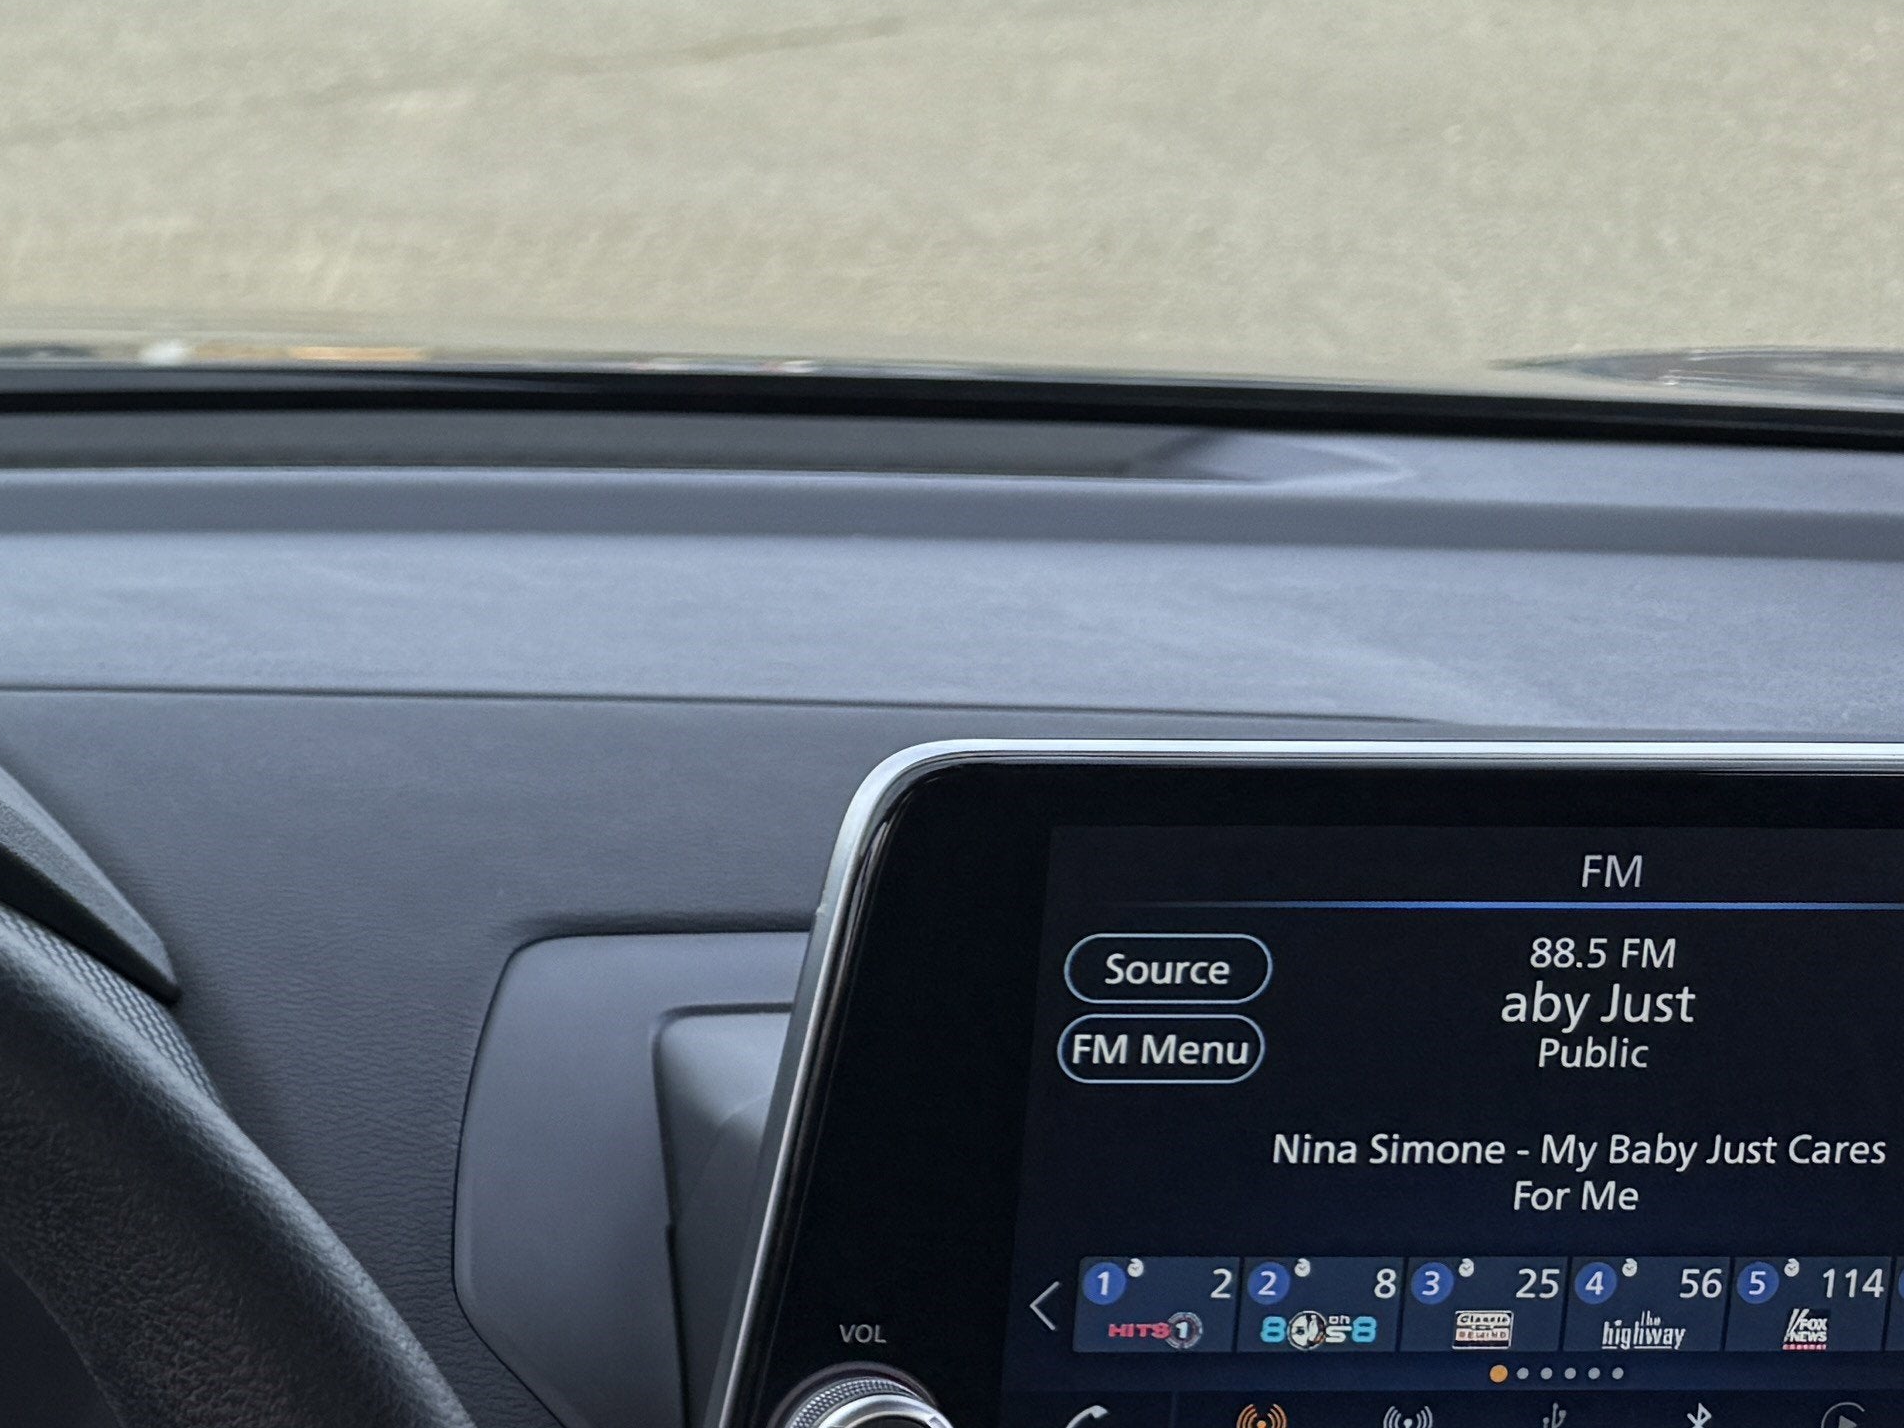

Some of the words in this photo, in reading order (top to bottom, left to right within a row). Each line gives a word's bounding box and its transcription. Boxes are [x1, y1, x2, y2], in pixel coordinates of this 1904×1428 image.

[1581, 854, 1644, 889] FM
[1529, 937, 1608, 969] 88.5
[1622, 938, 1676, 969] FM
[1104, 953, 1230, 986] Source
[1501, 980, 1590, 1034] aby
[1601, 982, 1696, 1024] Just
[1072, 1034, 1128, 1065] FM
[1141, 1035, 1249, 1065] Menu
[1538, 1035, 1649, 1068] Public
[1273, 1133, 1358, 1165] Nina
[1369, 1133, 1506, 1165] Simone
[1540, 1133, 1597, 1173] My
[1609, 1132, 1698, 1172] Baby
[1706, 1134, 1777, 1166] Just
[1788, 1133, 1887, 1166] Cares
[1513, 1180, 1570, 1211] For
[1582, 1181, 1639, 1211] Me
[1097, 1272, 1109, 1296] 1
[1210, 1268, 1232, 1299] 2
[1260, 1271, 1277, 1296] 2
[1374, 1268, 1397, 1299] 8
[1421, 1271, 1440, 1296] 3
[1515, 1268, 1560, 1299] 25
[1585, 1271, 1604, 1296] 4
[1679, 1268, 1723, 1299] 56
[1749, 1271, 1767, 1296] 5
[1823, 1268, 1884, 1299] 114
[839, 1324, 887, 1344] VOL
[1601, 1320, 1687, 1350] highway
[1792, 1330, 1828, 1343] NEWS
[1799, 1317, 1829, 1331] FOX
